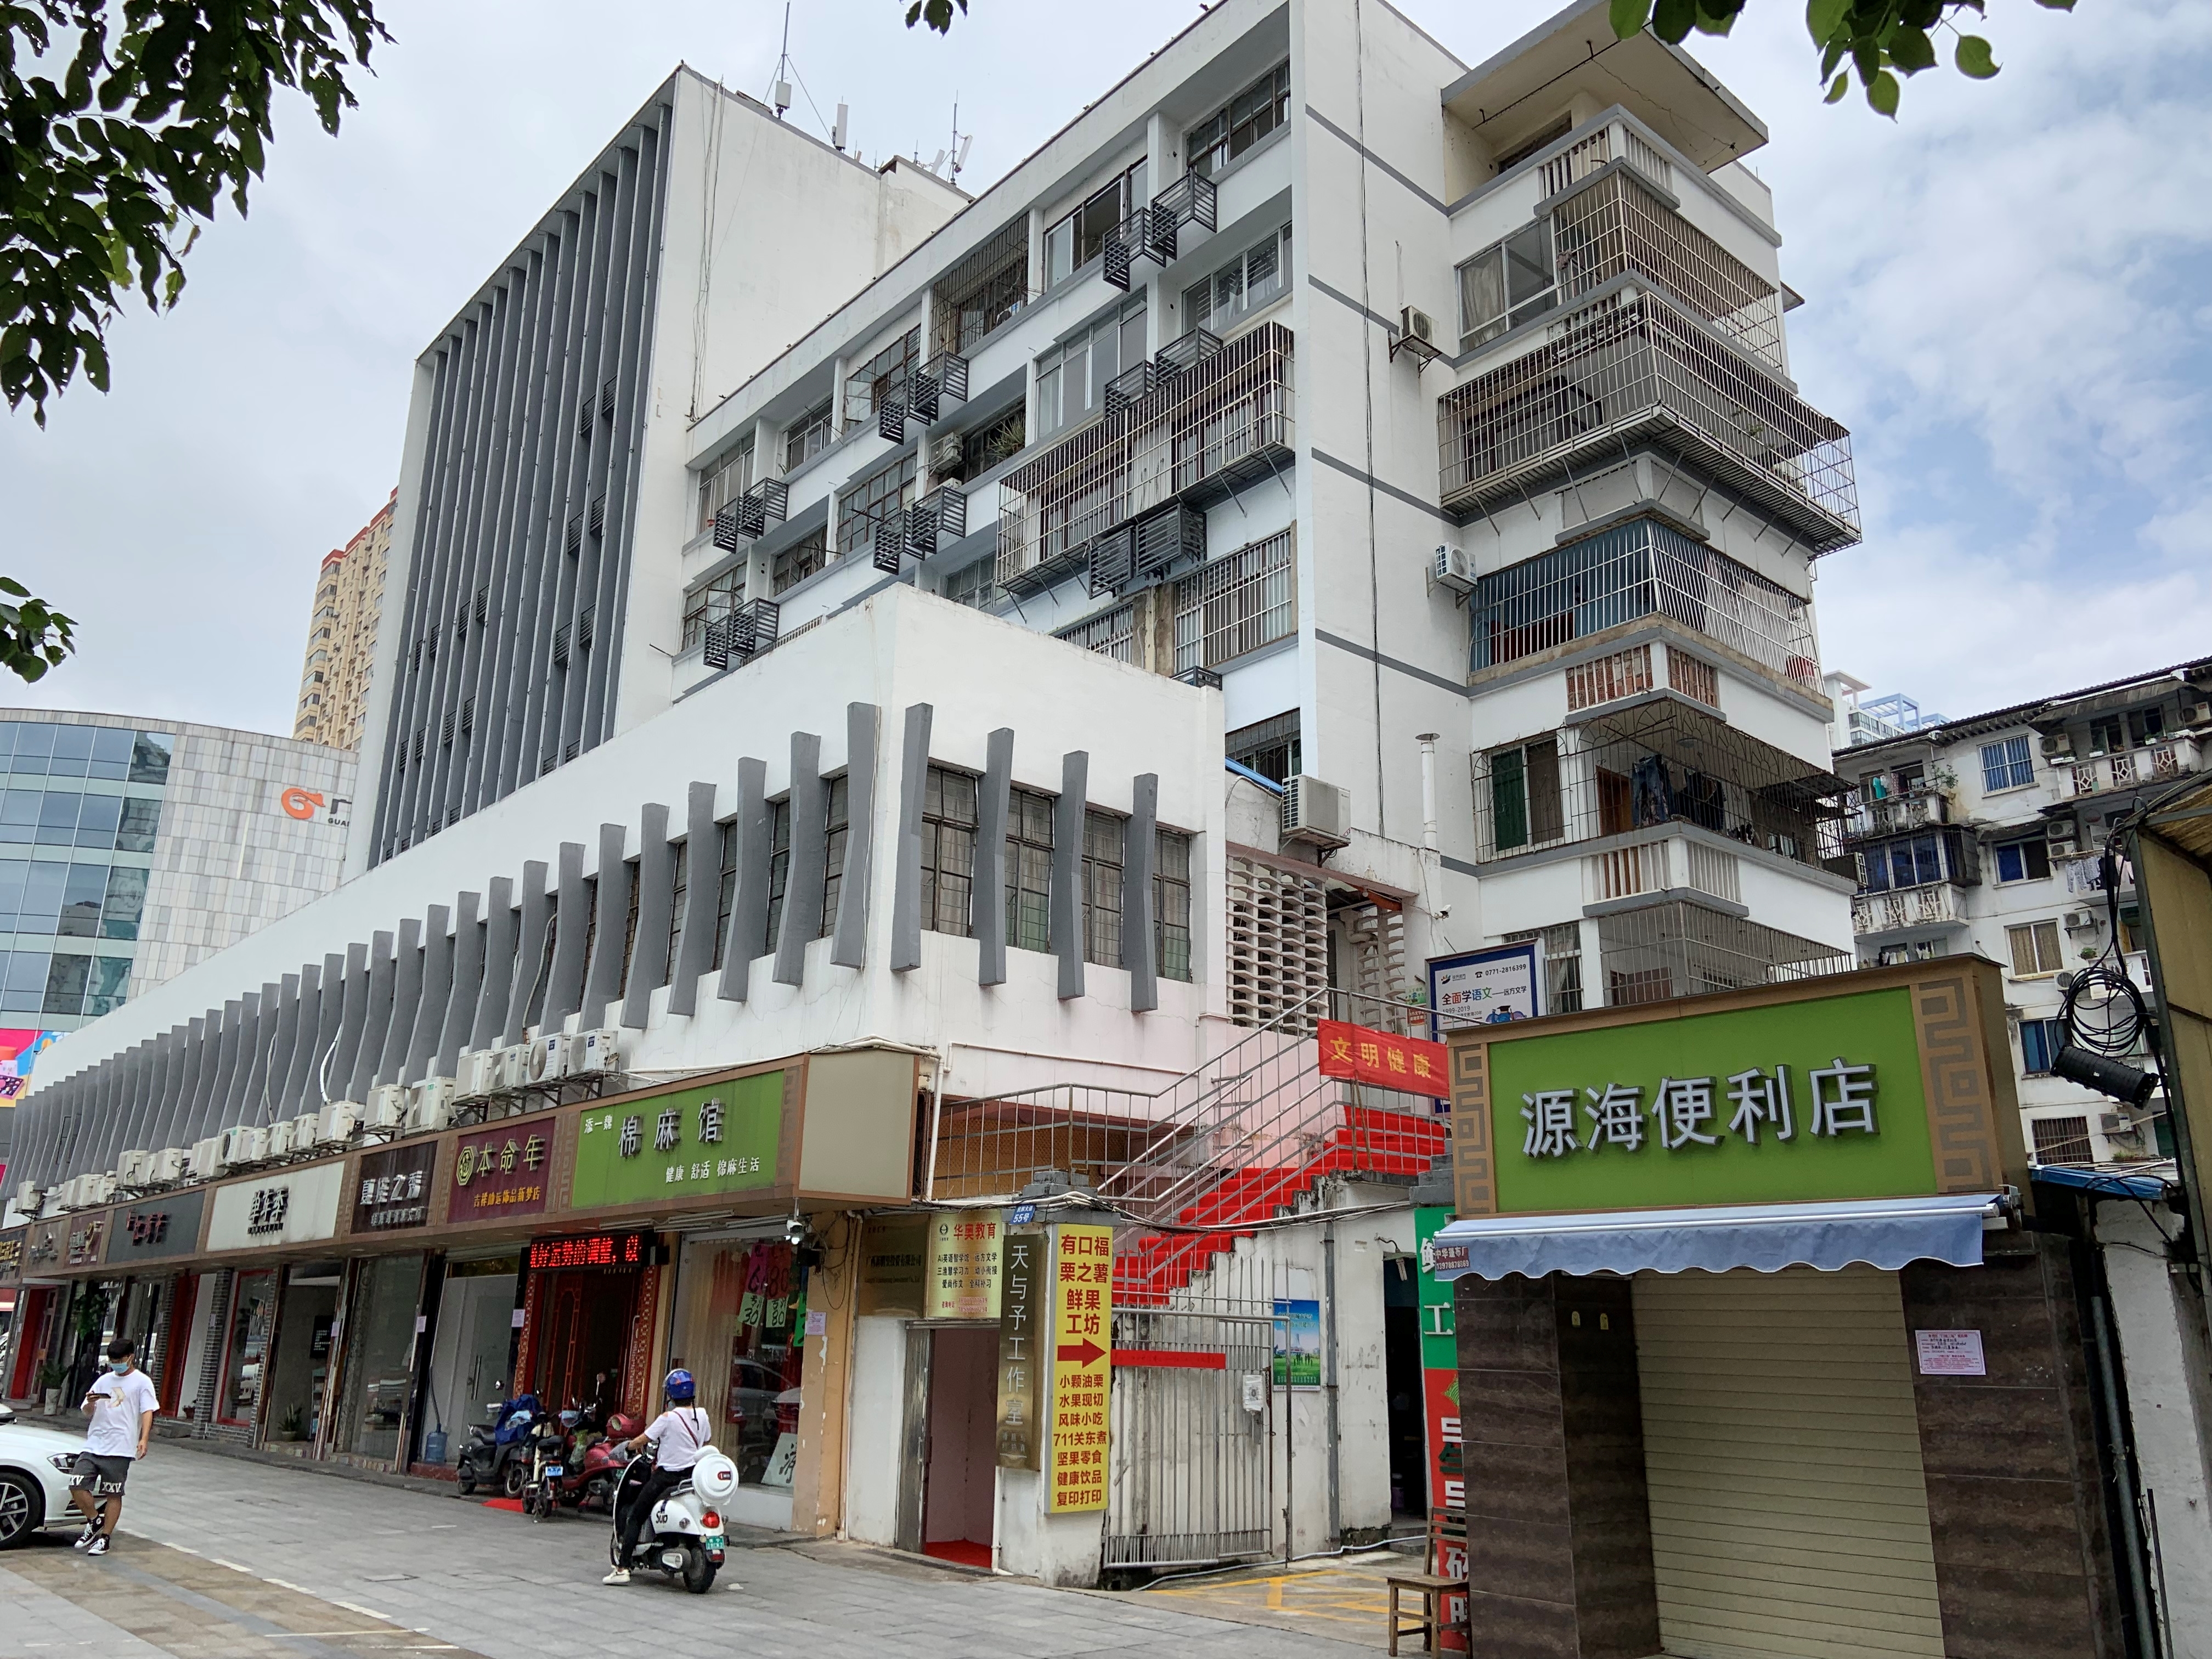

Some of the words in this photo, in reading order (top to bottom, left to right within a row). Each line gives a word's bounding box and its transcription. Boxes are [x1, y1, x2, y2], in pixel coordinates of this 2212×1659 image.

[1485, 964, 1526, 976] 0771-2816399
[1330, 1036, 1432, 1079] 文明健康
[1519, 1056, 1879, 1159] 源海便利店
[618, 1098, 725, 1158] 棉麻馆
[477, 1134, 545, 1177] 本命年
[665, 1165, 685, 1184] 健康
[691, 1160, 711, 1181] 舒适
[716, 1156, 760, 1177] 棉麻生活
[1013, 1212, 1030, 1223] 55号
[953, 1222, 996, 1240] 华奥教育
[1061, 1234, 1109, 1257] 有口福
[974, 1252, 997, 1262] 远方文学
[975, 1265, 997, 1275] 幼小衔接
[1060, 1262, 1109, 1284] 栗之薯
[942, 1279, 963, 1288] 爱尚作文
[969, 1279, 991, 1288] 全科补习
[1066, 1288, 1101, 1311] 鲜果
[742, 1307, 759, 1325] 30
[771, 1310, 785, 1326] 80
[1066, 1313, 1101, 1335] 工坊
[1424, 1302, 1457, 1336] 工
[1006, 1245, 1029, 1425] 天与予工作室
[1060, 1374, 1104, 1389] 小颗油栗
[1059, 1393, 1103, 1408] 水果现切
[1059, 1412, 1103, 1427] 风味小吃
[1053, 1431, 1107, 1447] 711关东煮
[1057, 1449, 1102, 1466] 坚果零食
[1057, 1470, 1102, 1487] 健康饮品
[1057, 1489, 1102, 1506] 复印打印
